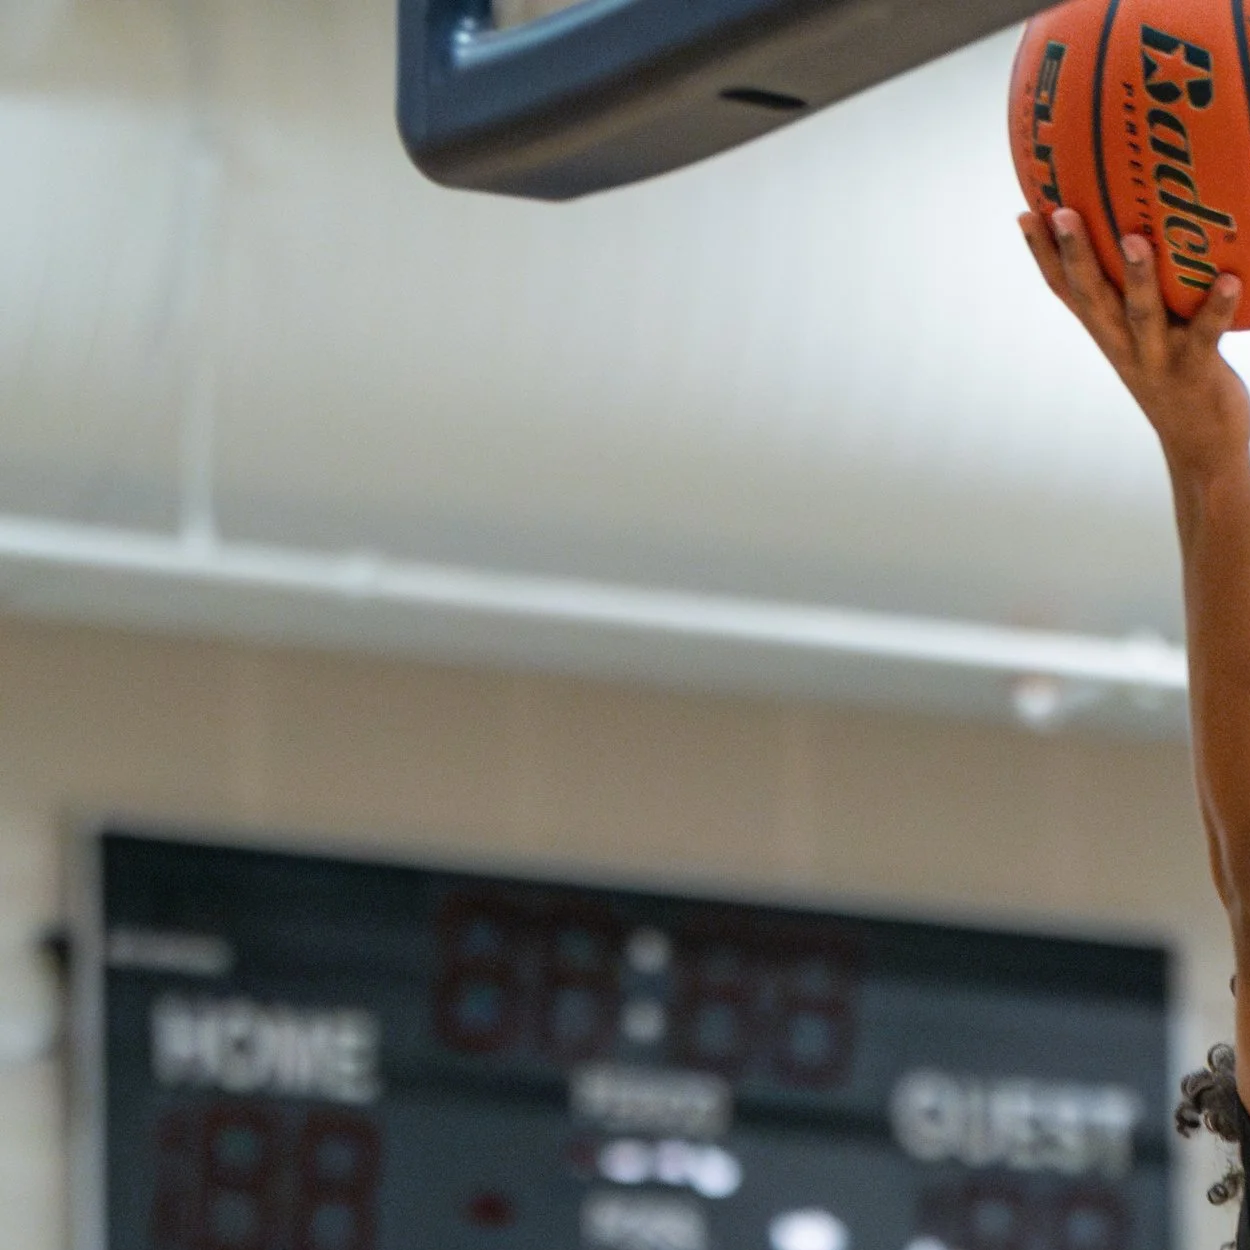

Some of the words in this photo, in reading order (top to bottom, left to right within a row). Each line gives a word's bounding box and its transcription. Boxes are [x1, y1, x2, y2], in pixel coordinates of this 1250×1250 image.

[1032, 39, 1068, 208] ELIT
[1121, 80, 1156, 242] PERFECTIO
[1140, 23, 1238, 292] Baden
